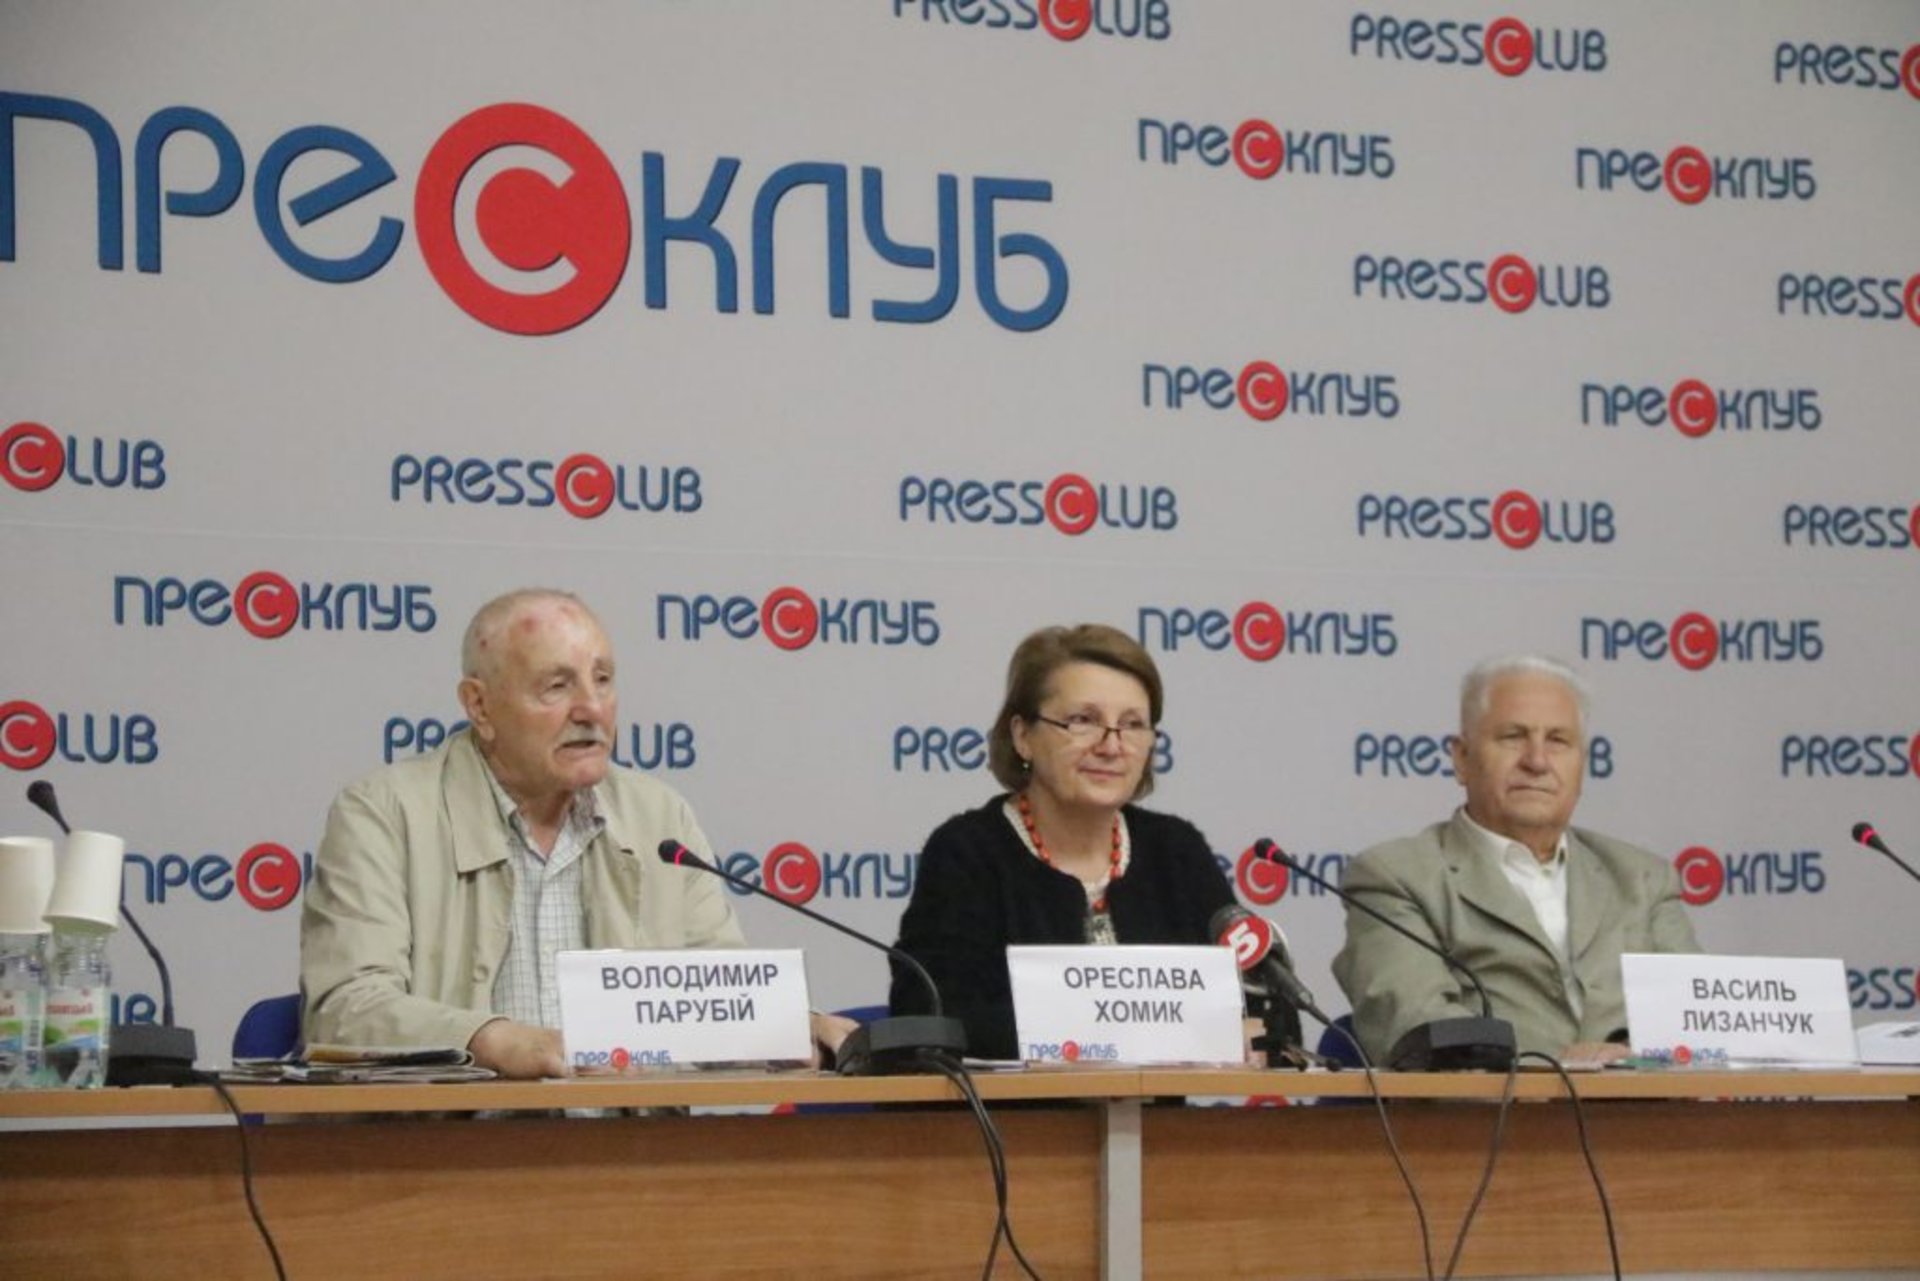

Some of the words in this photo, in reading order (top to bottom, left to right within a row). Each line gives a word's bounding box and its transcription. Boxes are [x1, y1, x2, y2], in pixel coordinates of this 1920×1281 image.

[602, 963, 778, 991] ВОЛОДИМИР
[1064, 966, 1205, 991] ОРЕСЛАВА
[1692, 978, 1797, 1002] ВАСИЛЬ
[636, 996, 755, 1024] ПАРУБІЙ
[1094, 1001, 1183, 1023] ХОМИК
[1683, 1010, 1814, 1034] ЛИЗАНЧУК
